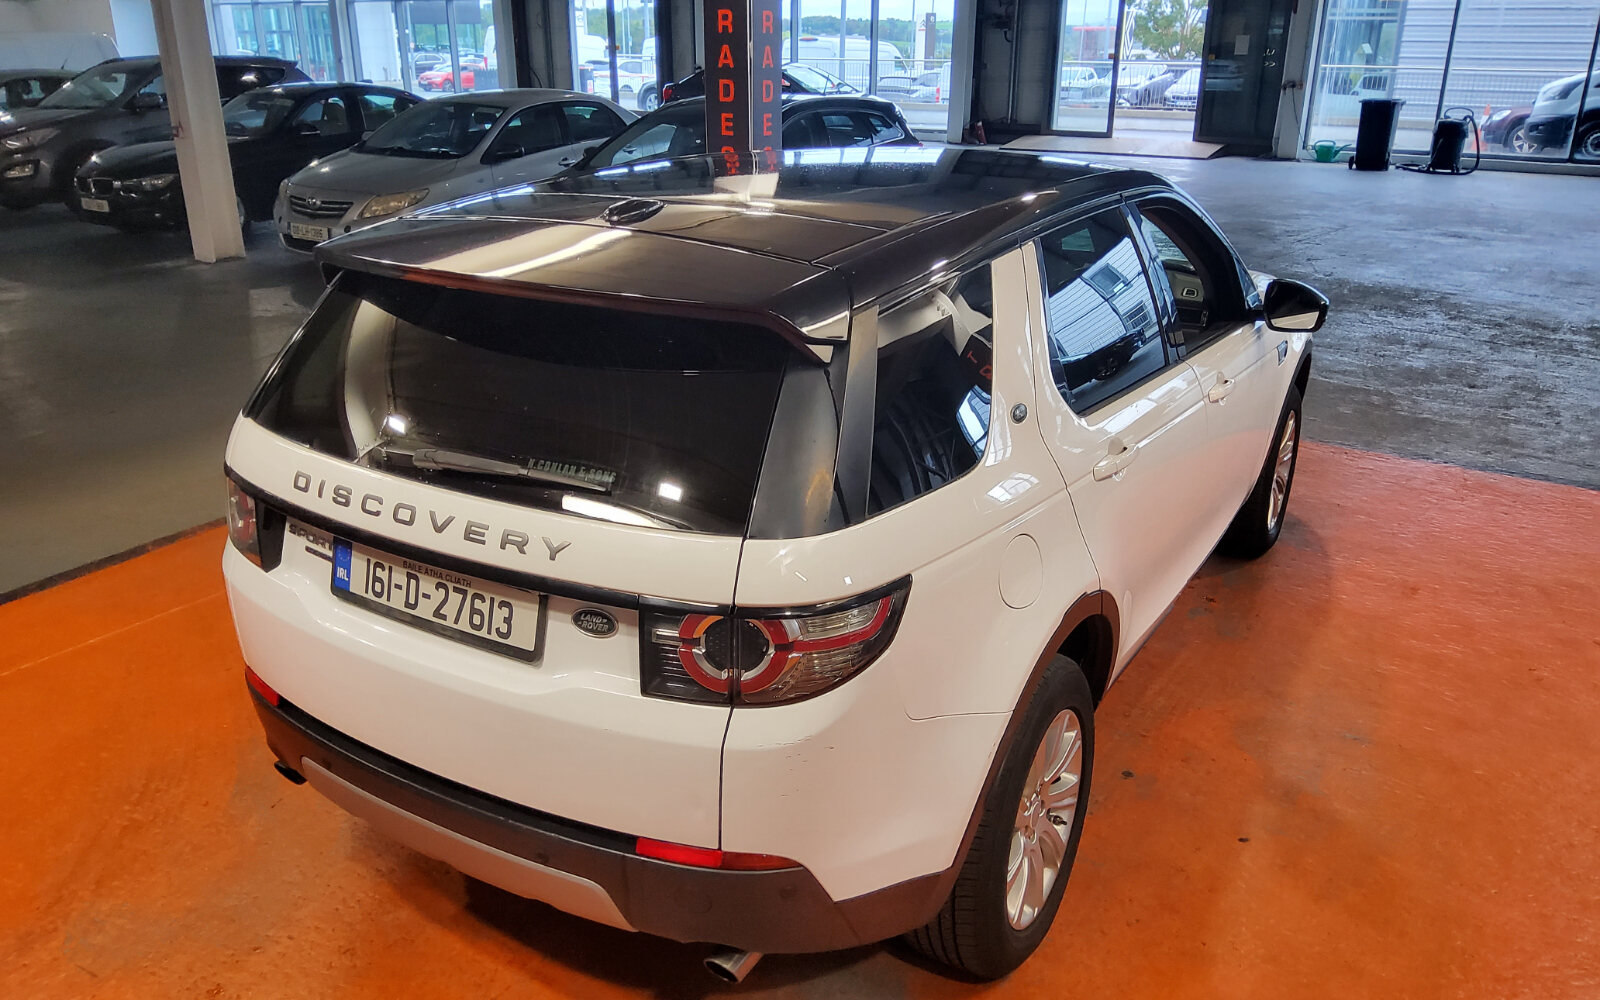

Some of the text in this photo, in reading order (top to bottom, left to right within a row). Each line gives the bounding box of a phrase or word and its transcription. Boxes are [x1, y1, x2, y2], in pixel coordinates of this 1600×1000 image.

[293, 470, 572, 561] DISCOVERY
[336, 566, 349, 581] IRL
[402, 560, 423, 573] BAILE
[445, 574, 472, 588] CLIATH
[364, 557, 514, 640] 161-D-27613
[580, 612, 603, 623] LAND
[581, 620, 609, 632] ROVER
